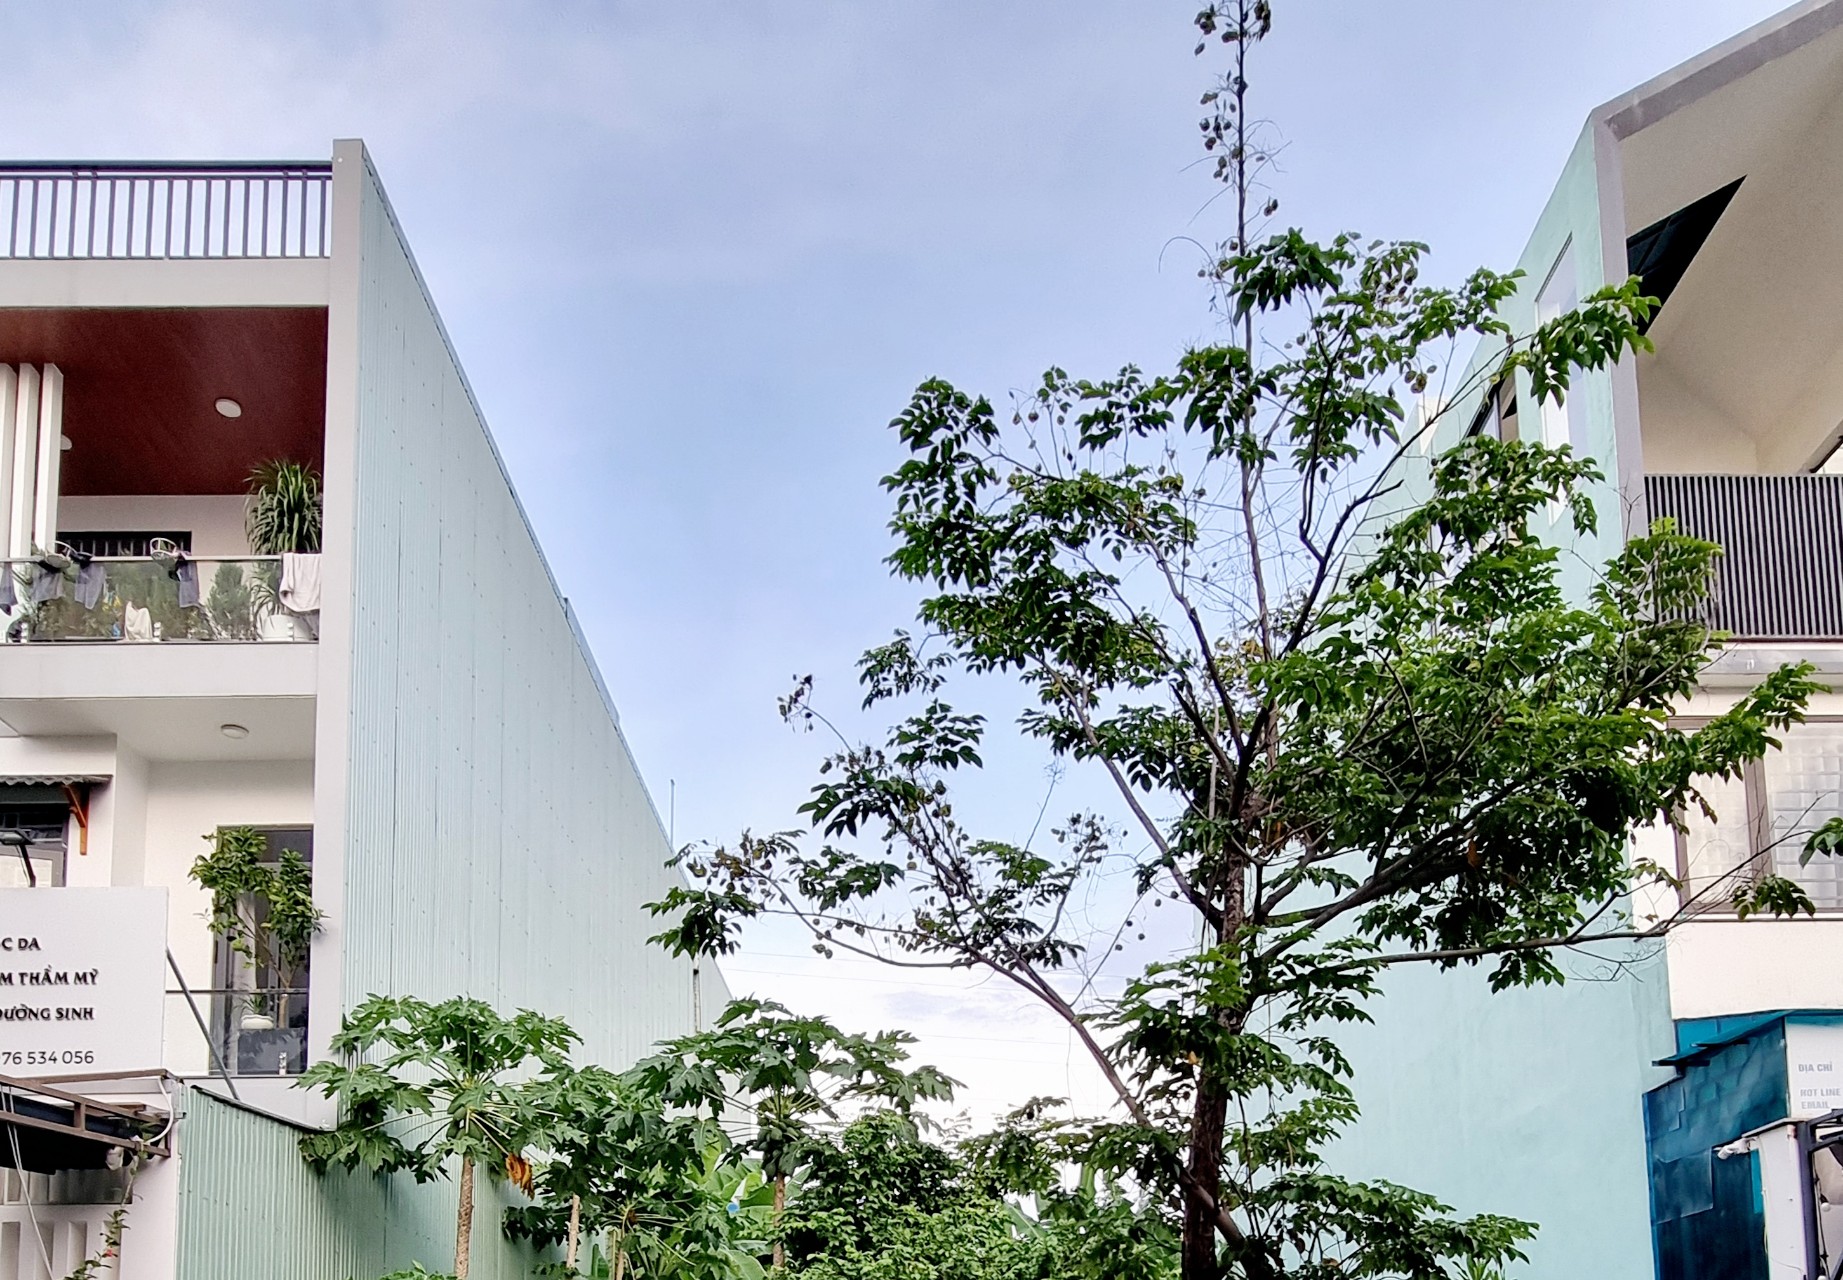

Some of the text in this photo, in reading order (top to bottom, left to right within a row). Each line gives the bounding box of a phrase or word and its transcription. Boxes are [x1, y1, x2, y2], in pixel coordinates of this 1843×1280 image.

[18, 937, 41, 951] DA
[55, 1007, 94, 1021] SINH
[1, 1050, 94, 1065] 76 534 056
[1800, 1088, 1841, 1097] HOT LINE
[1801, 1101, 1830, 1110] EMAIL
